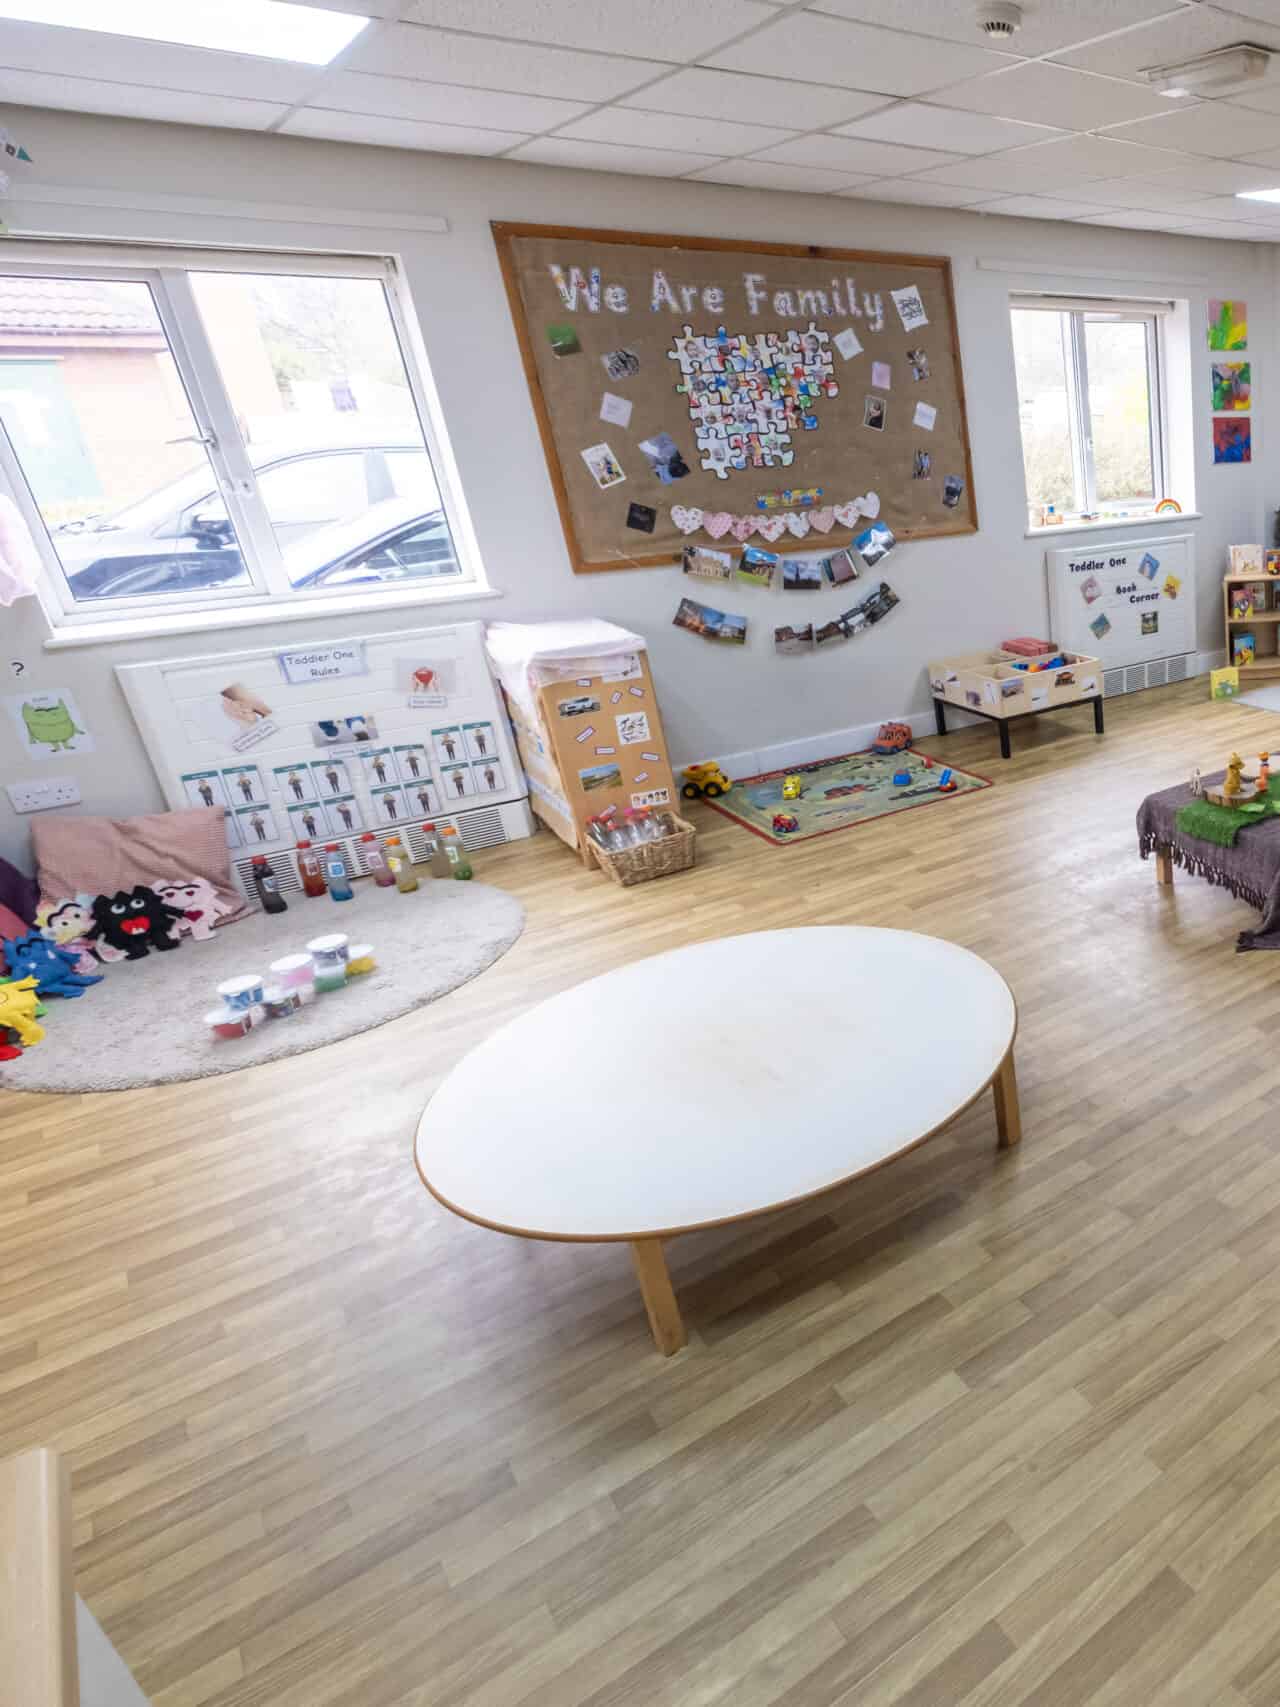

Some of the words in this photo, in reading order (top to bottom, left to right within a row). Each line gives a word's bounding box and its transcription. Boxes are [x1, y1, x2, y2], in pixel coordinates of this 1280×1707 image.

[549, 263, 629, 313] We
[651, 269, 725, 314] Are
[742, 272, 884, 332] Family
[1069, 561, 1105, 573] Toddler
[1109, 557, 1127, 568] One
[1115, 582, 1137, 595] Book
[1129, 592, 1160, 604] Corner
[286, 653, 329, 666] Toddler
[333, 650, 354, 661] One
[11, 661, 24, 676] ?
[310, 667, 341, 678] Rules
